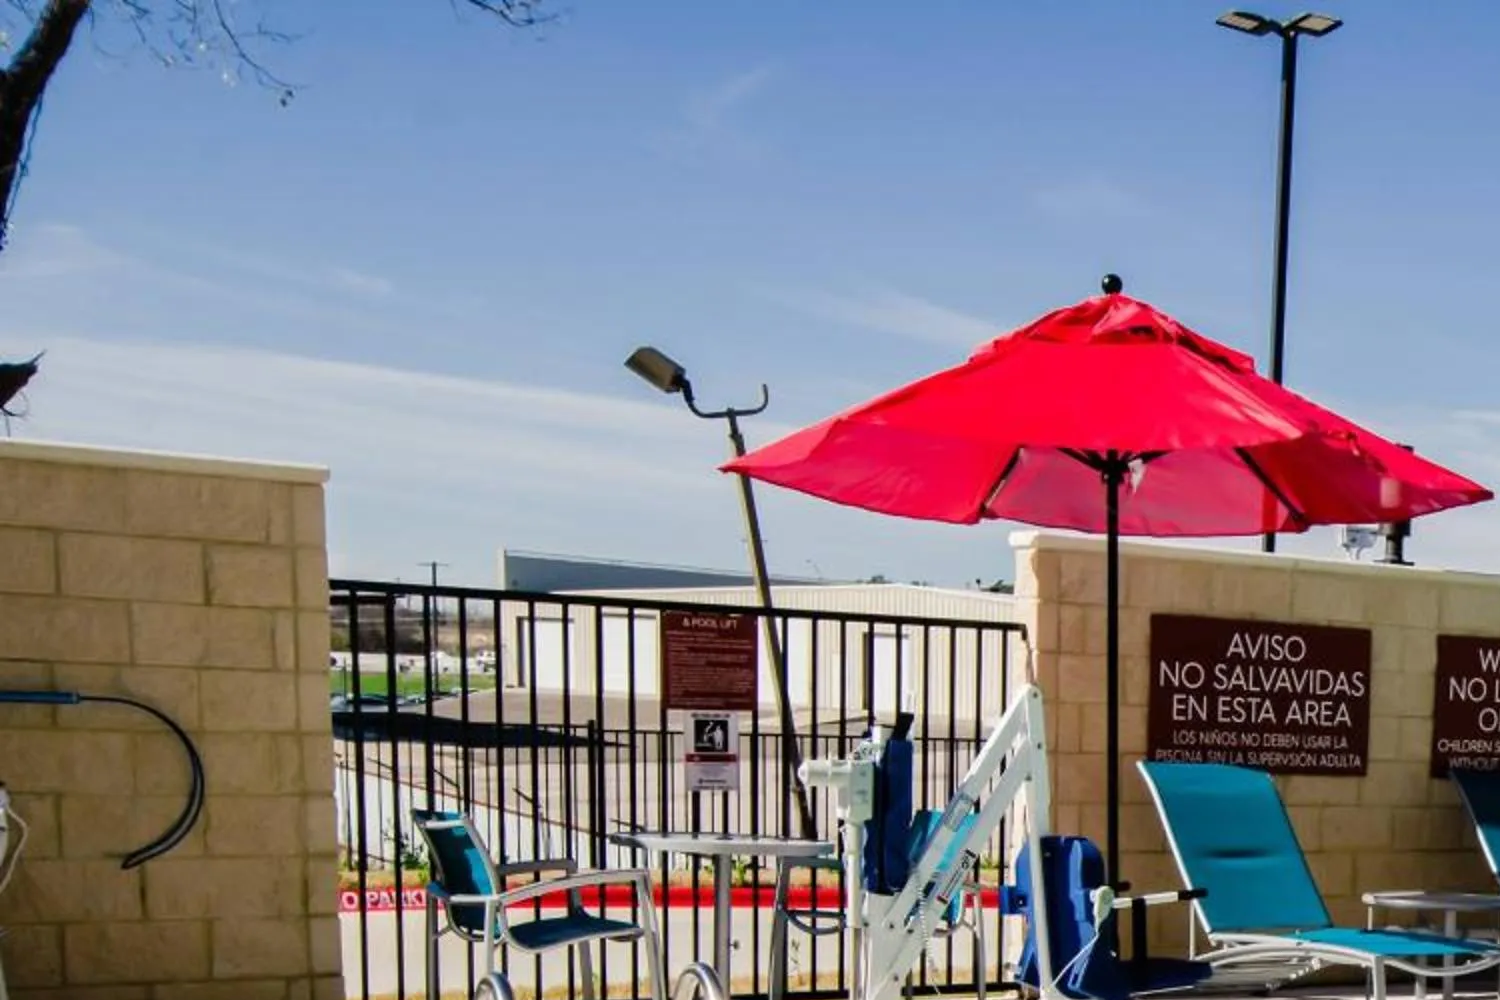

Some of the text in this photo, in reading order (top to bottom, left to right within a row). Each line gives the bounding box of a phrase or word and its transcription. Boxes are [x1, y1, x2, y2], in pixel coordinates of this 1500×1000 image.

[1226, 632, 1307, 662] AVISO
[1159, 660, 1365, 697] NO SALVAVIDAS
[1449, 676, 1487, 702] NO
[1172, 694, 1351, 727] EN ESTA AREA
[1173, 728, 1349, 750] LOS NIÑOS NO DEBEN USAR LA
[1437, 738, 1493, 754] CHILDREN
[1155, 747, 1202, 763] PISCINA
[1207, 749, 1226, 764] SIN
[1229, 750, 1245, 765] LA
[1319, 752, 1361, 769] ADULTA
[1448, 756, 1500, 771] WITHOUT
